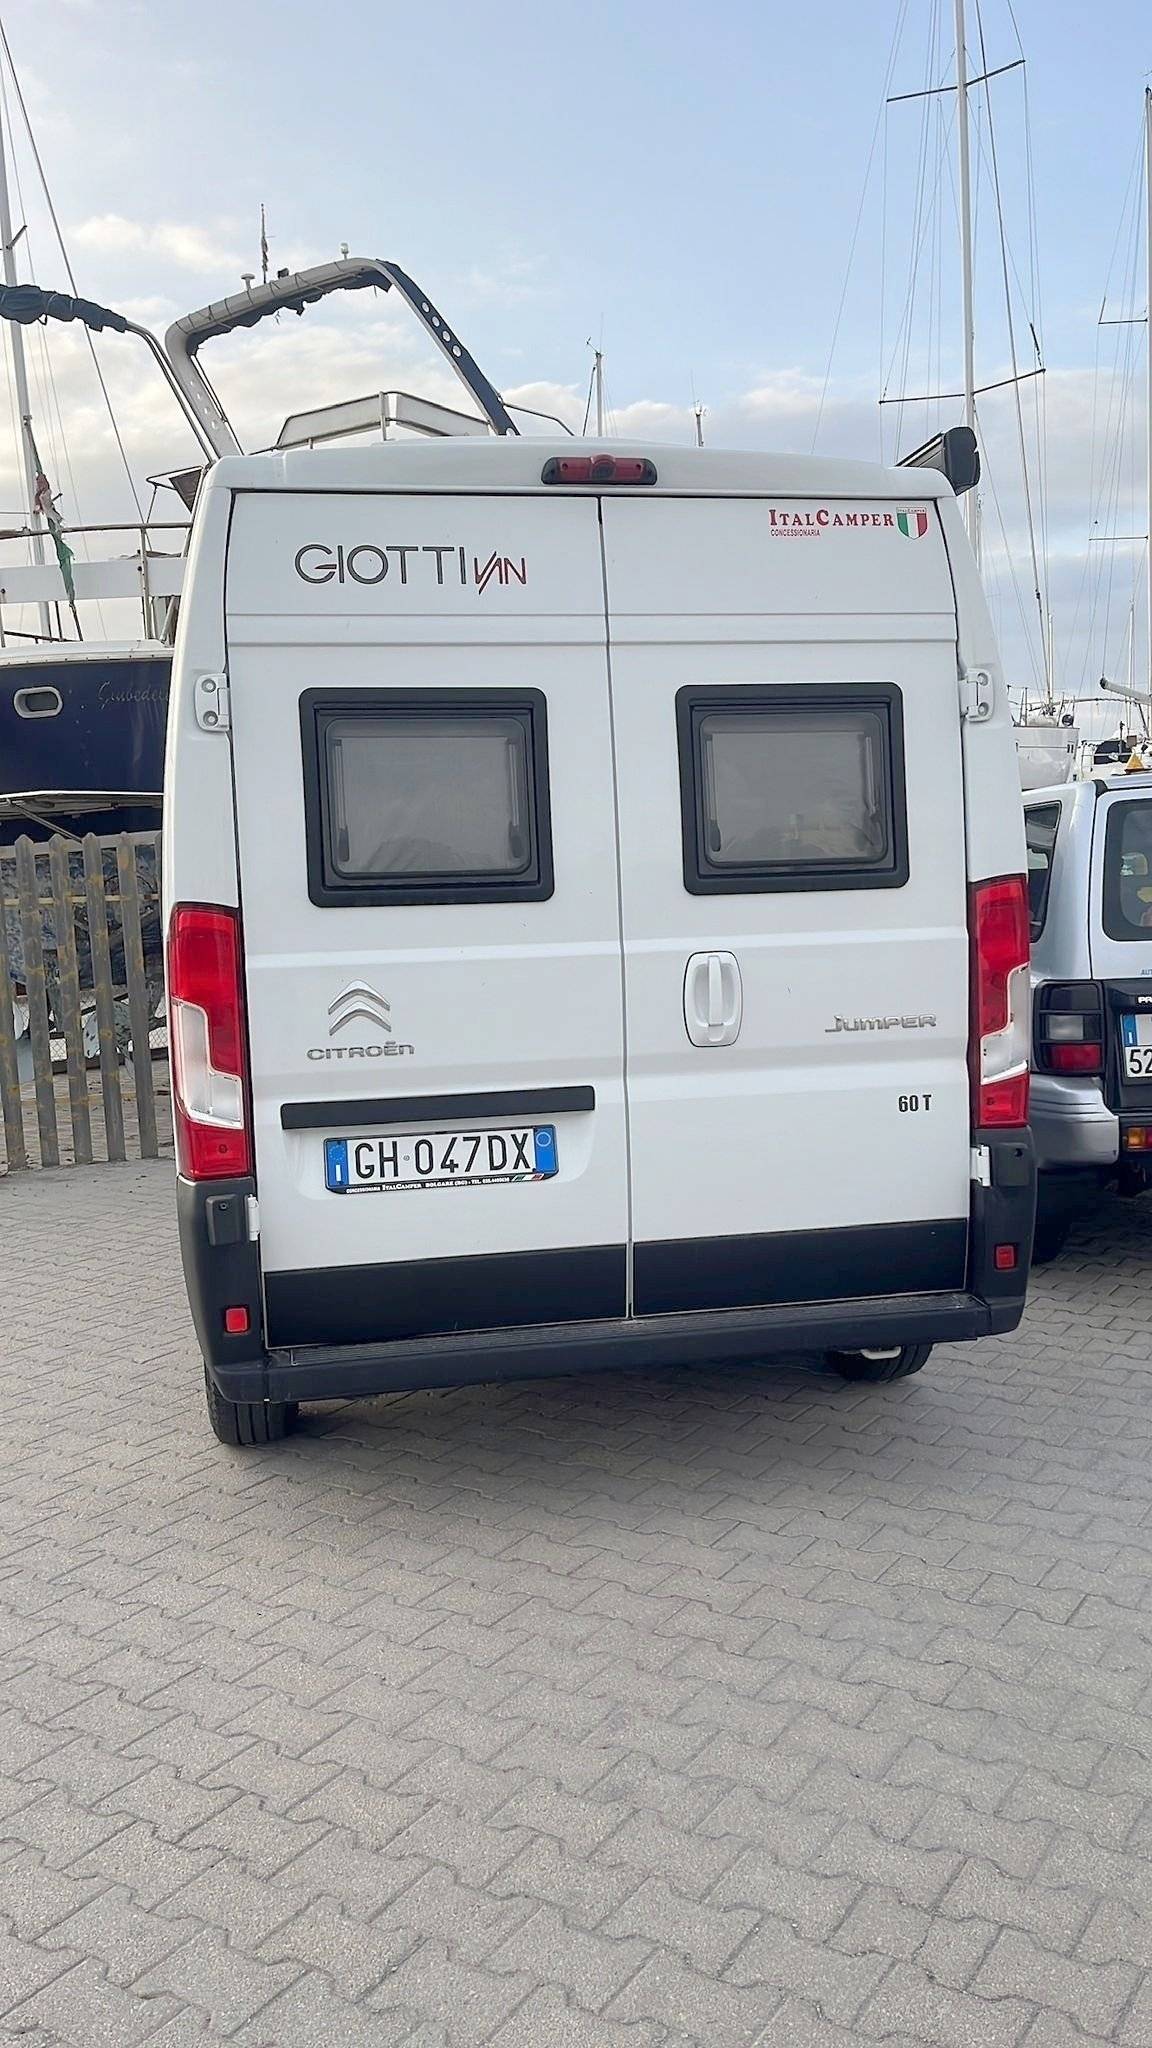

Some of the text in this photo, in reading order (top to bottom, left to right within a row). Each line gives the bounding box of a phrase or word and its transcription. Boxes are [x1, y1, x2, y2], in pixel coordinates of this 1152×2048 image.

[771, 529, 820, 537] CONCESSIONARIA
[1129, 1049, 1152, 1075] 52
[898, 1094, 932, 1112] 60 T
[355, 1140, 399, 1179] GH
